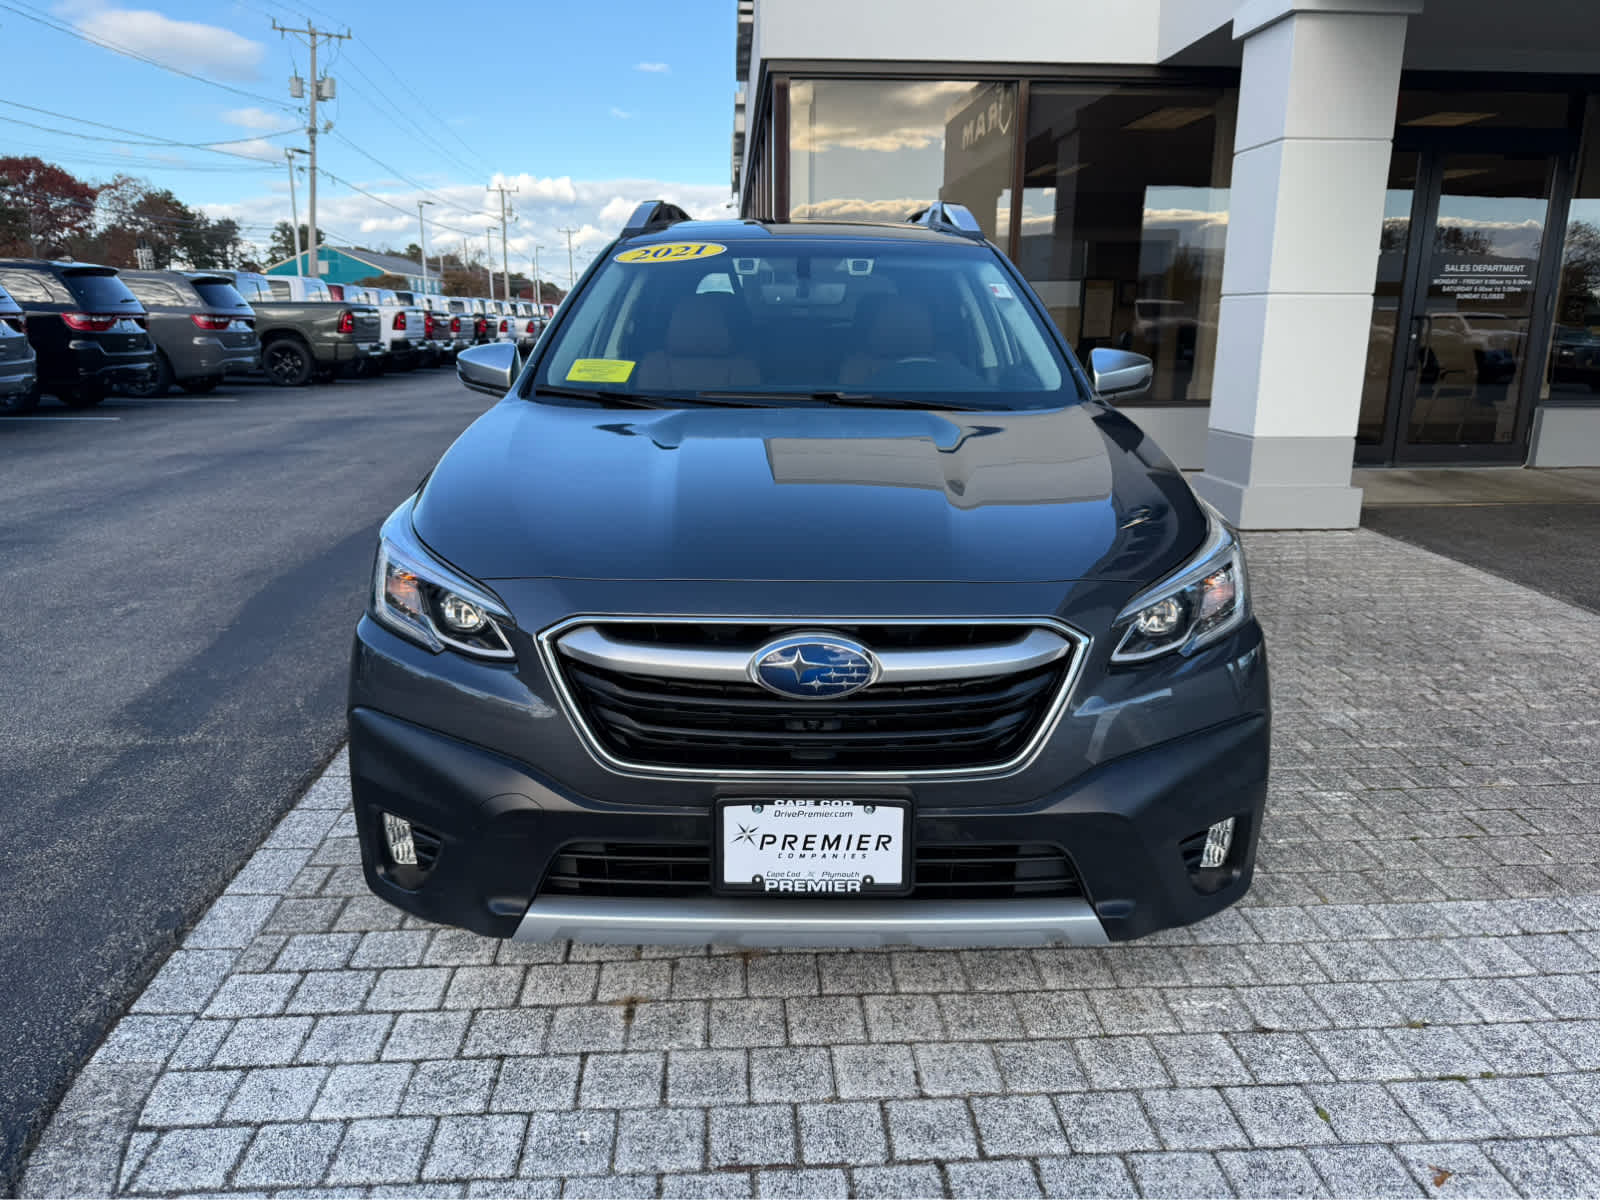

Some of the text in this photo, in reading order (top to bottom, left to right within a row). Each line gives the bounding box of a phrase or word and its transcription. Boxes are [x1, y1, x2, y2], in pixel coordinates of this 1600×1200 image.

[632, 245, 708, 260] 2021
[1444, 264, 1526, 273] SALES DEPARTMENT
[774, 810, 854, 819] DrivePremier.com
[759, 834, 892, 851] PREMIER
[766, 871, 785, 879] Cape
[821, 871, 860, 879] Plymouth
[765, 879, 861, 892] PREMIER
